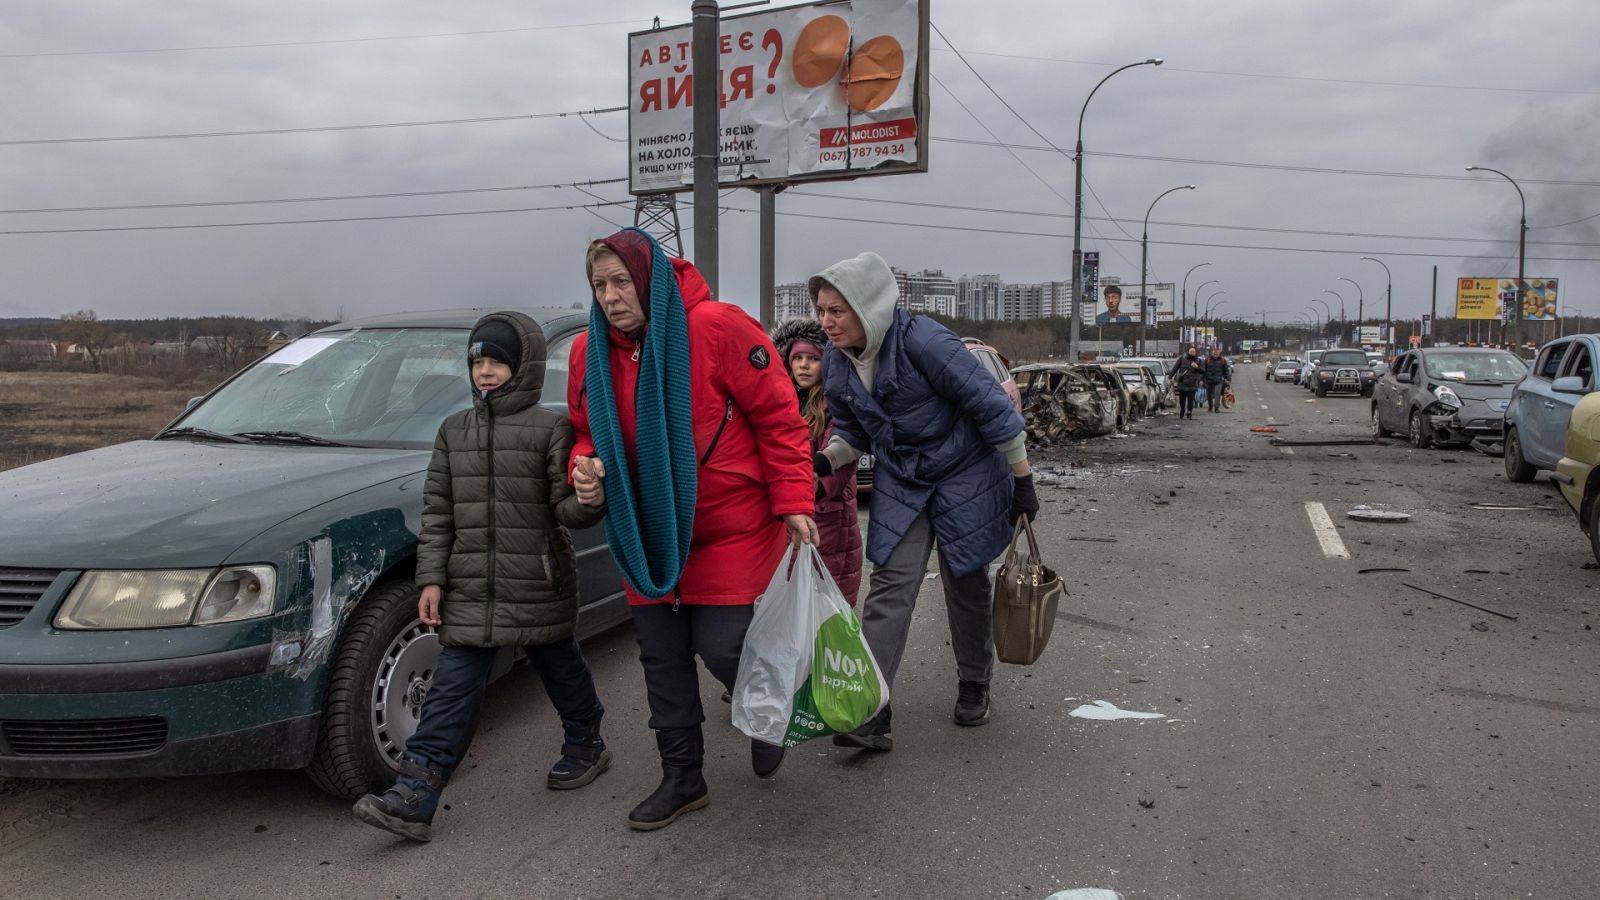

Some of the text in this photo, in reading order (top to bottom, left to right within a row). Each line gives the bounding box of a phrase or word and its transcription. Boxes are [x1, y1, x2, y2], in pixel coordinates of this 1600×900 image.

[638, 133, 686, 147] МІНЯЄМО
[725, 124, 754, 137] ЯЄЦЬ
[851, 126, 900, 141] MOLODIST
[638, 151, 655, 162] НА
[819, 143, 905, 164] (067) 787 94 34
[639, 164, 665, 175] ЯКЩО
[667, 160, 694, 173] КУПУЄ
